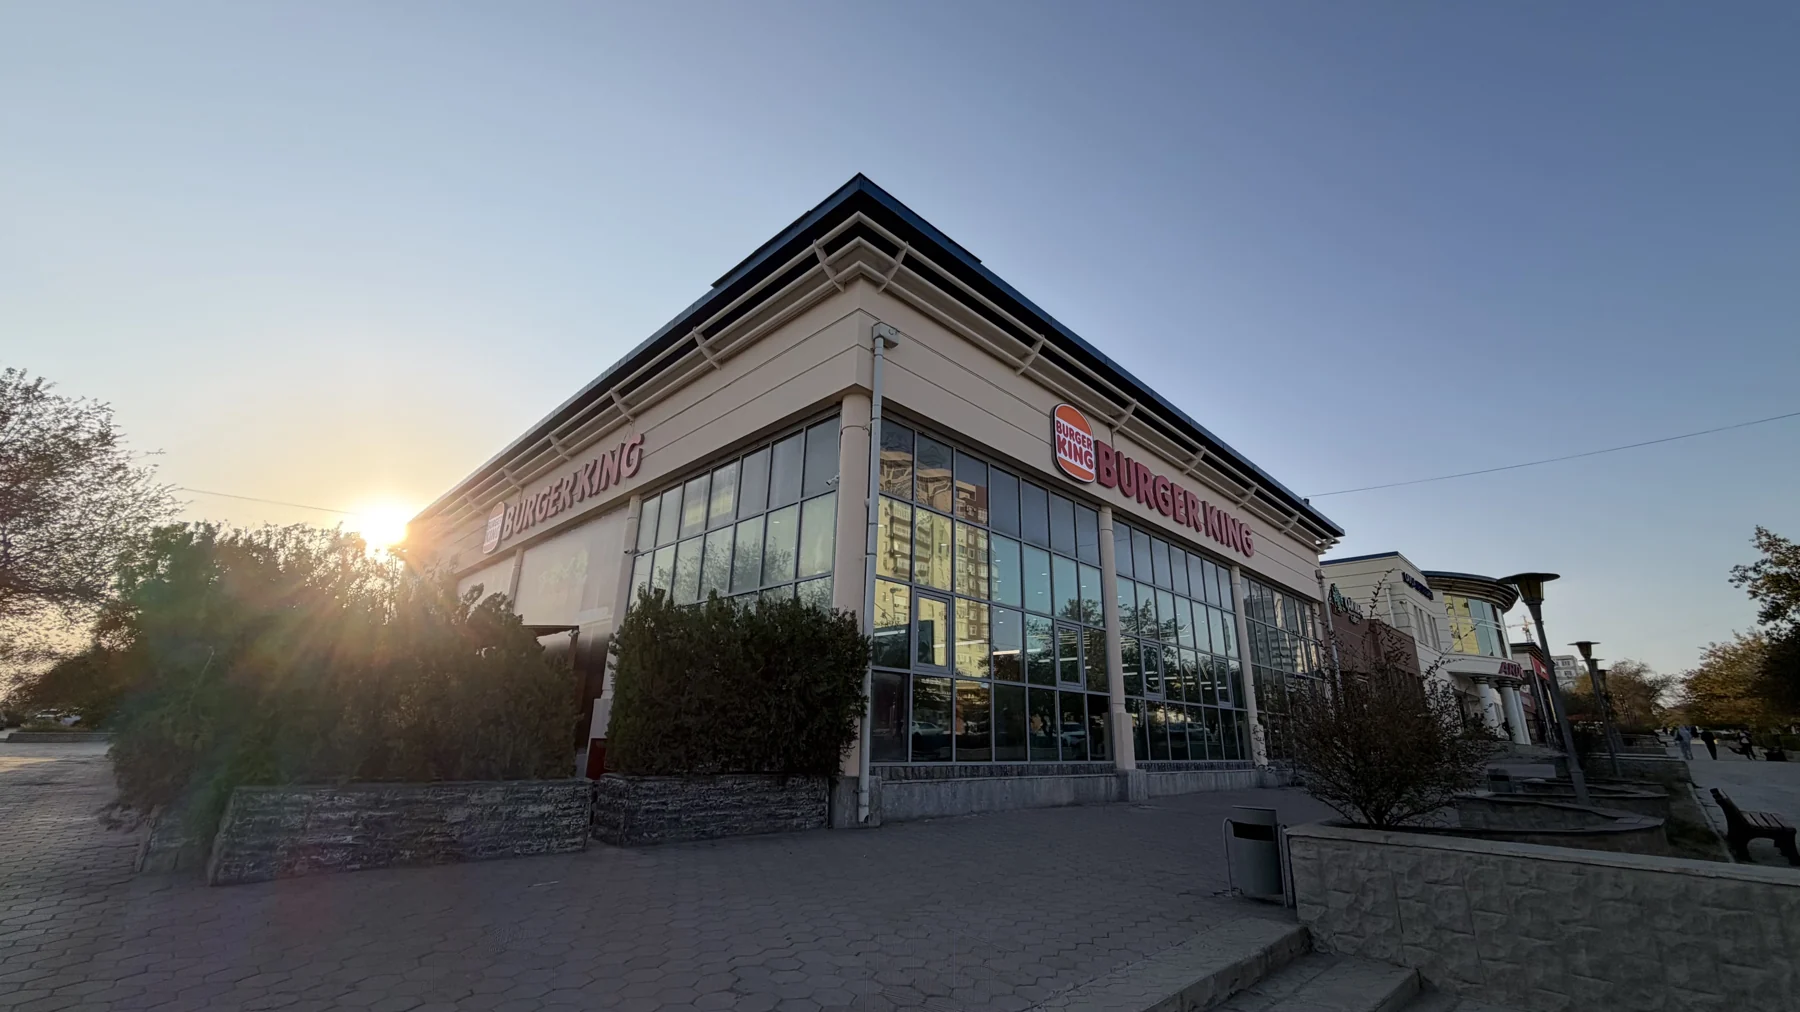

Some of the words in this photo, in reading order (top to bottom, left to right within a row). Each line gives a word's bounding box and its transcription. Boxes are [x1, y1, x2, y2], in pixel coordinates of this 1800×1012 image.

[1056, 420, 1093, 452] BURGER
[1057, 434, 1094, 470] KING
[501, 472, 577, 541] BURGER
[576, 433, 645, 503] KING
[1095, 440, 1202, 533] BURGER
[1201, 501, 1255, 558] KING
